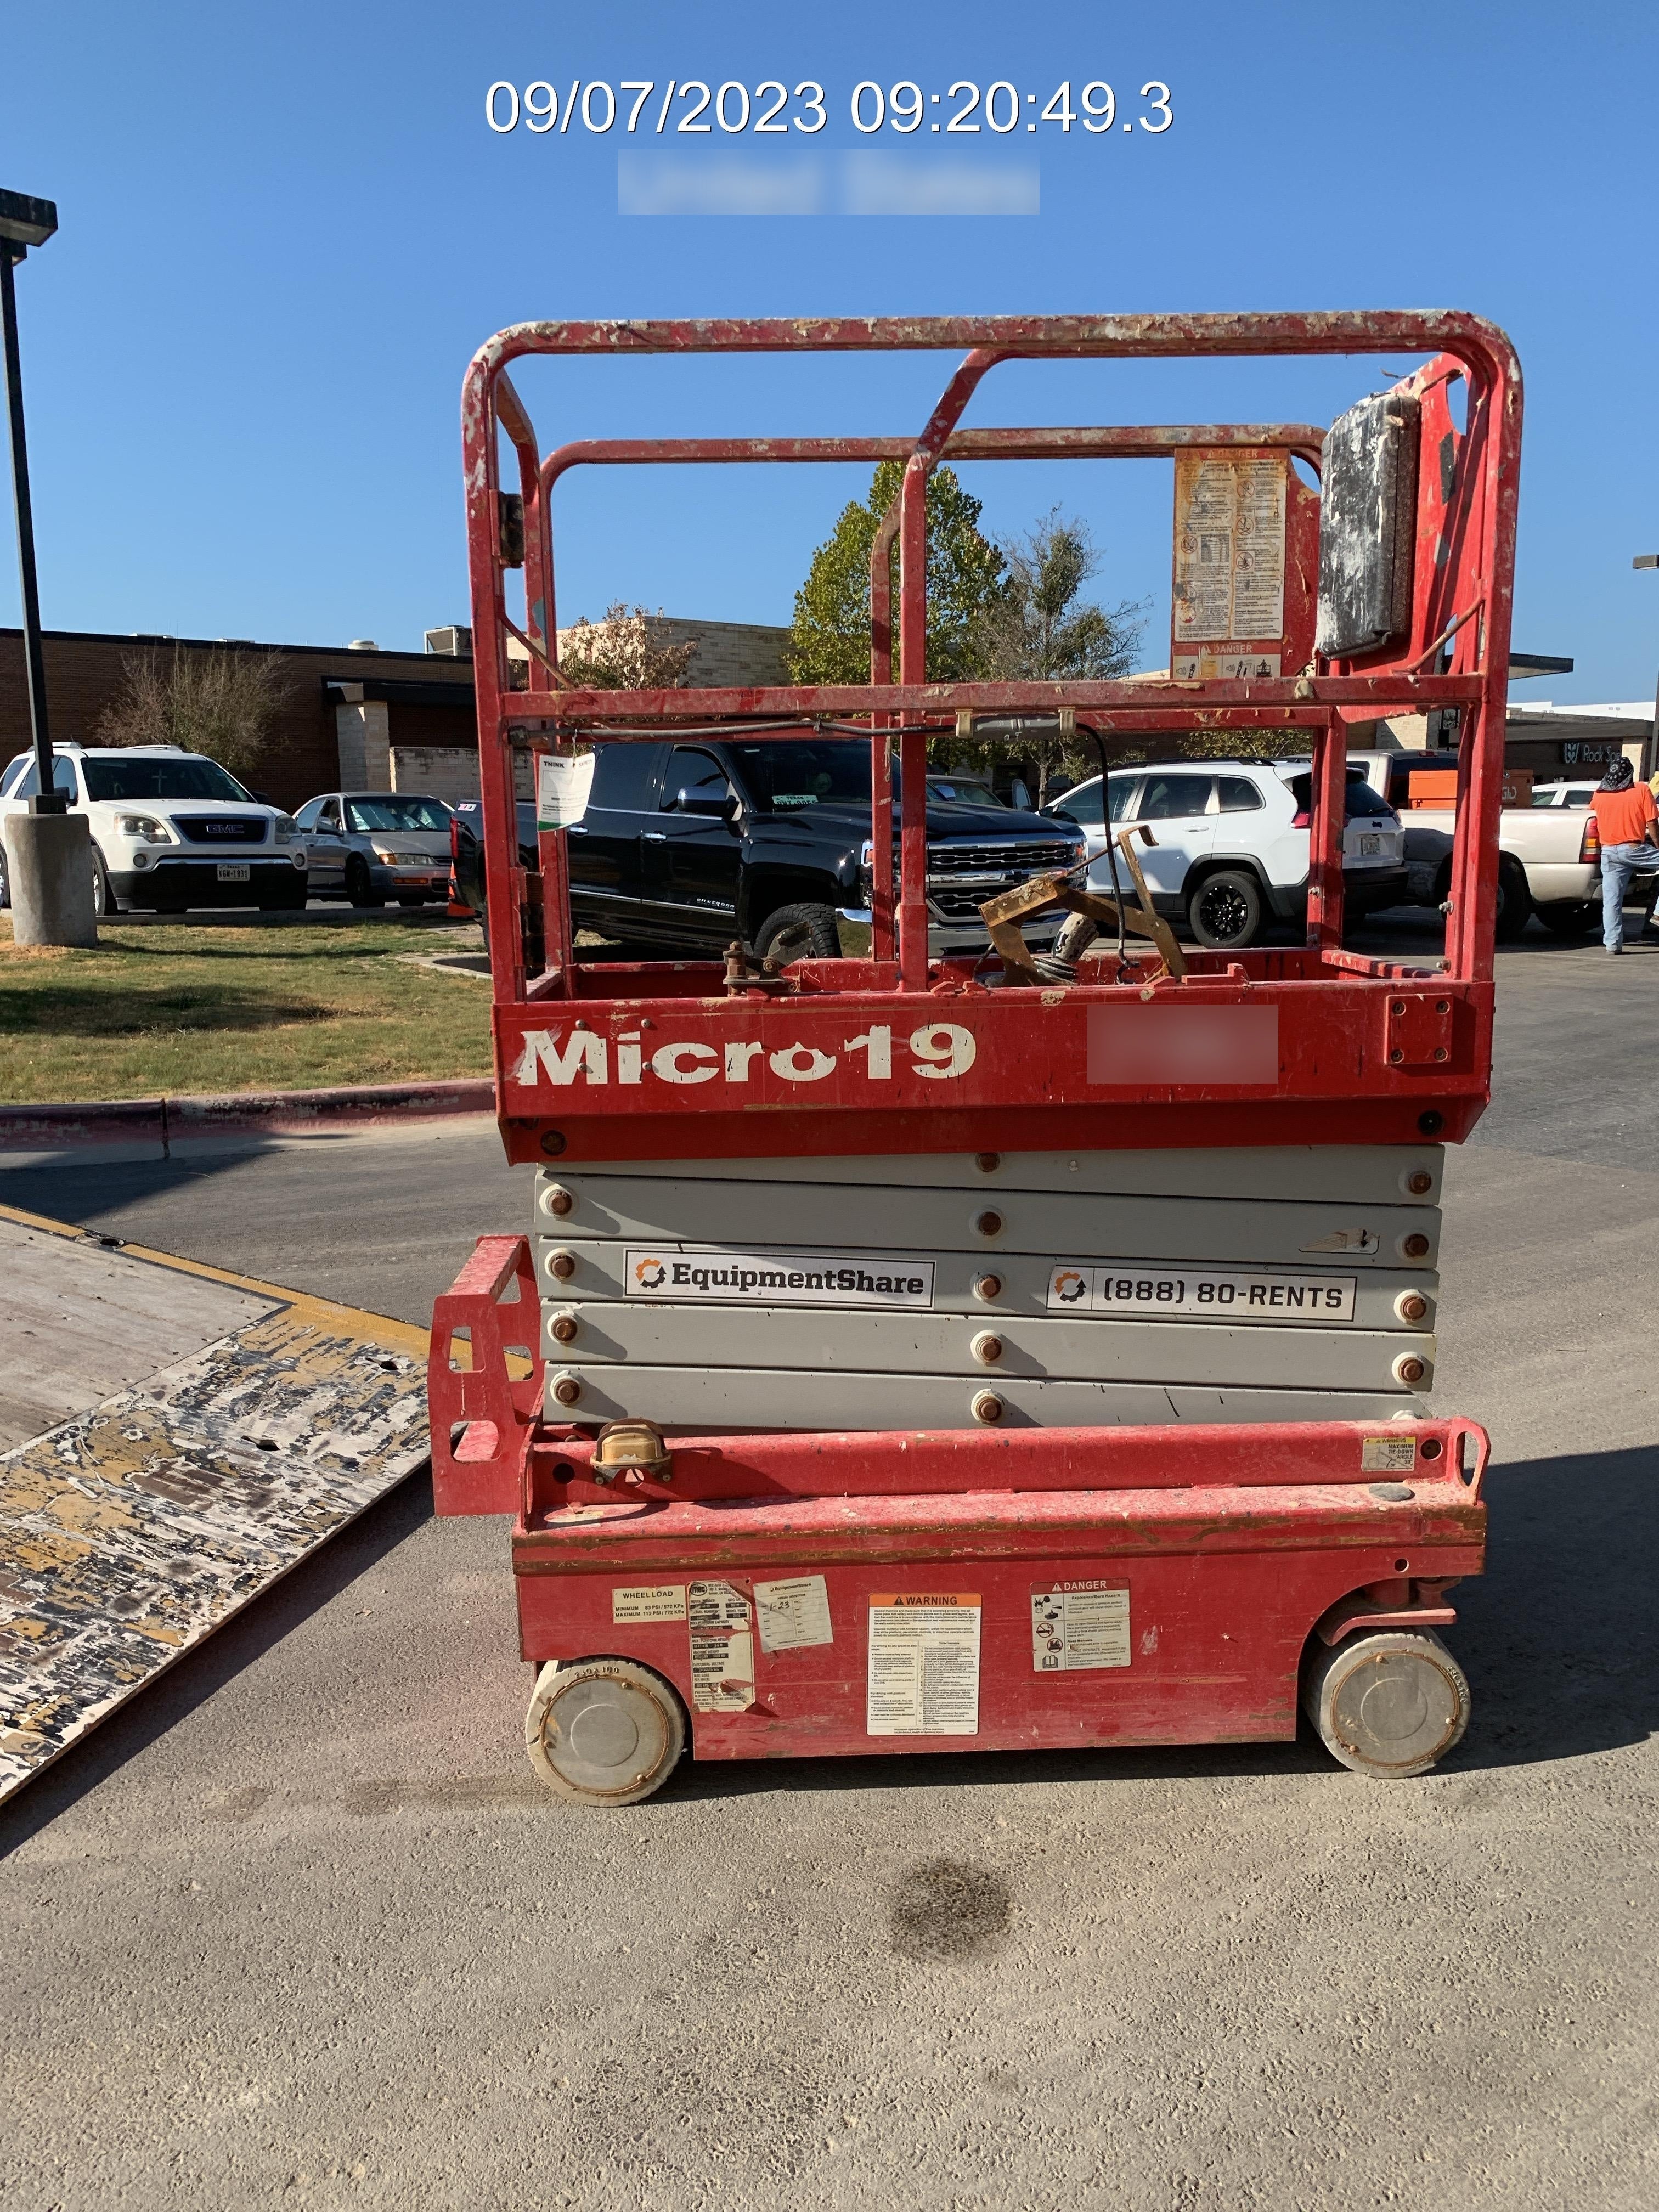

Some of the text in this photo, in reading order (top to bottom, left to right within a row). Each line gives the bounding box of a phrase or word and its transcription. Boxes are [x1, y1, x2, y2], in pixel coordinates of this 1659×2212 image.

[1584, 744, 1603, 763] Rock
[206, 825, 245, 833] GMC
[672, 1263, 924, 1294] EquipmentShare
[1104, 1277, 1343, 1308] (888) 80-RENTS
[1064, 1580, 1107, 1590] DANGER
[906, 1596, 958, 1605] WARNING
